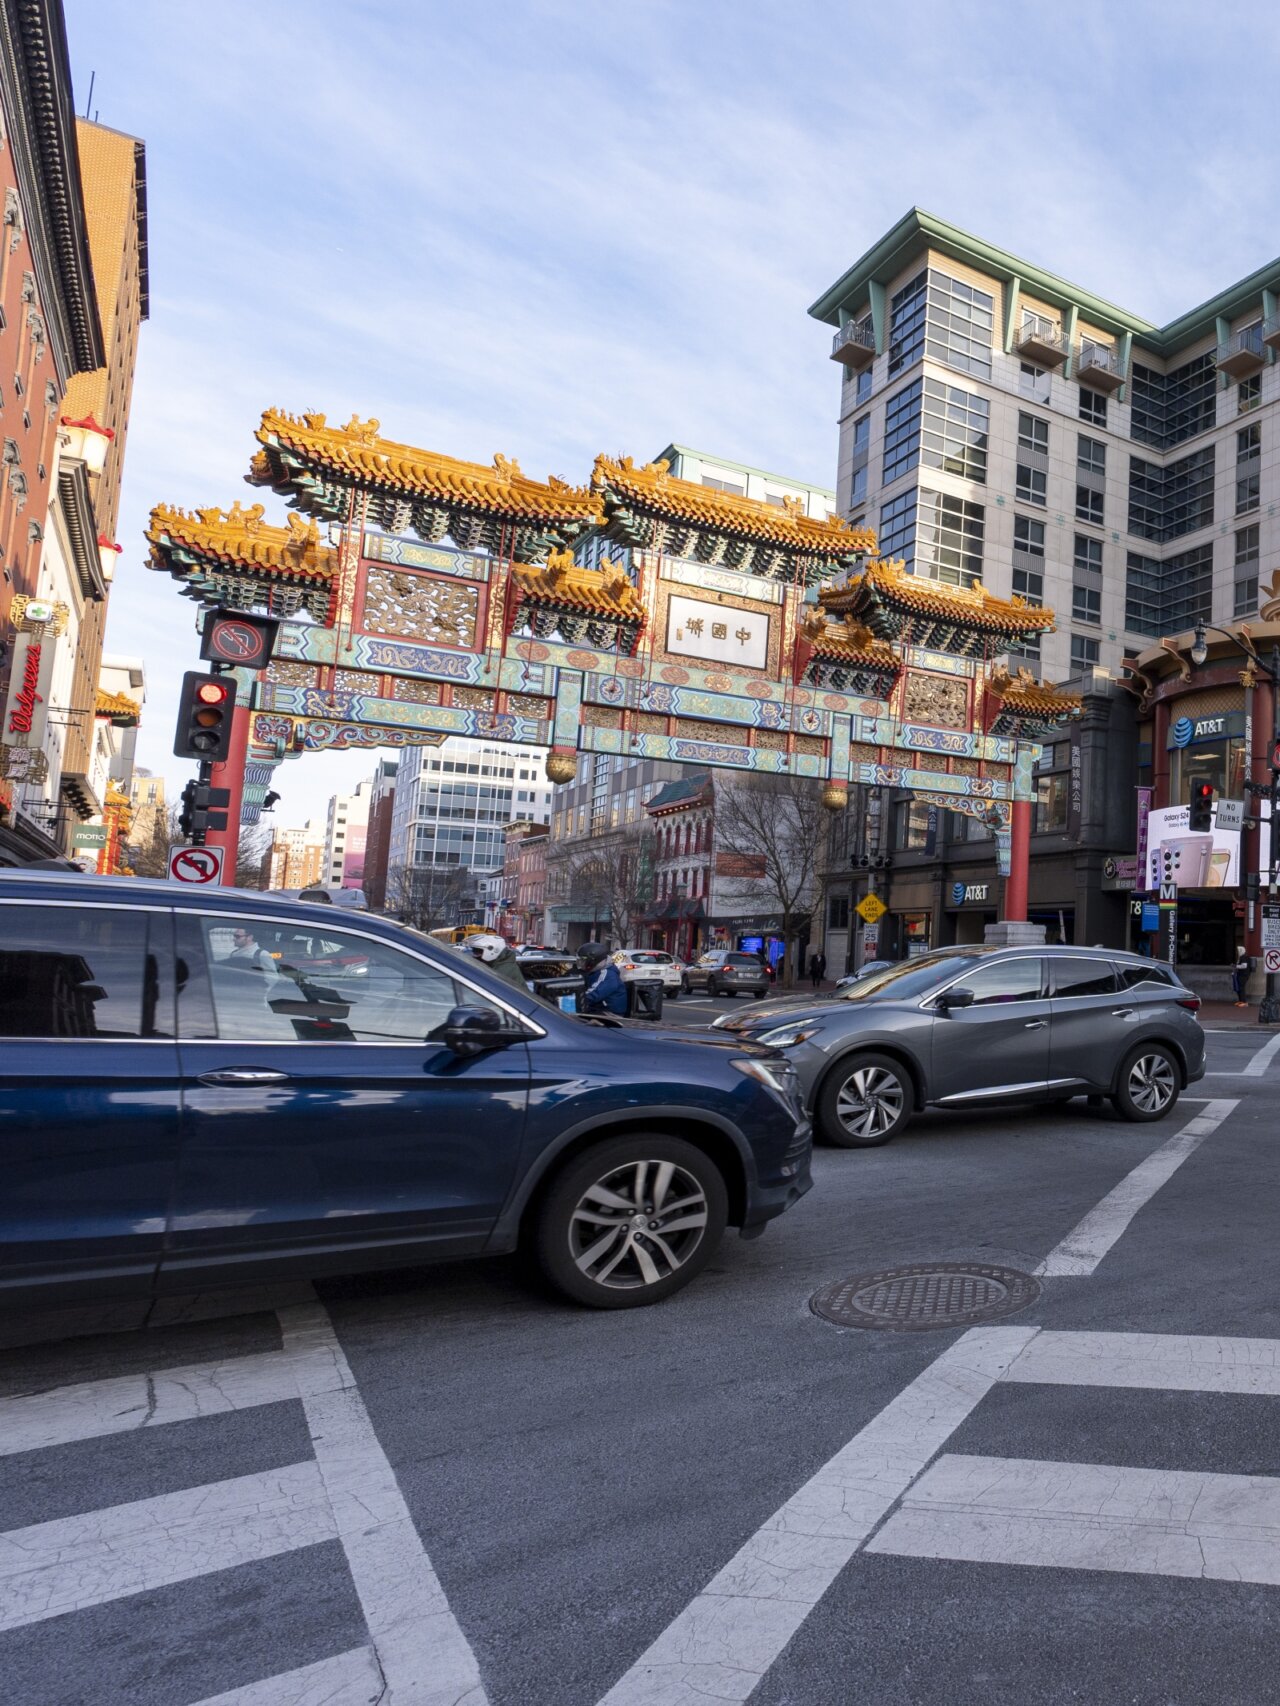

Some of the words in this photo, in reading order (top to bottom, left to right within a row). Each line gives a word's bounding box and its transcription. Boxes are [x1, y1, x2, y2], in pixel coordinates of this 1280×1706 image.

[10, 643, 43, 733] Walgreens
[1194, 718, 1225, 737] AT&T
[1226, 803, 1236, 811] NO
[1164, 814, 1180, 822] Galaxy
[1220, 813, 1240, 824] TURNS
[964, 884, 989, 901] AT&T
[1160, 884, 1175, 899] M
[865, 933, 877, 941] 25
